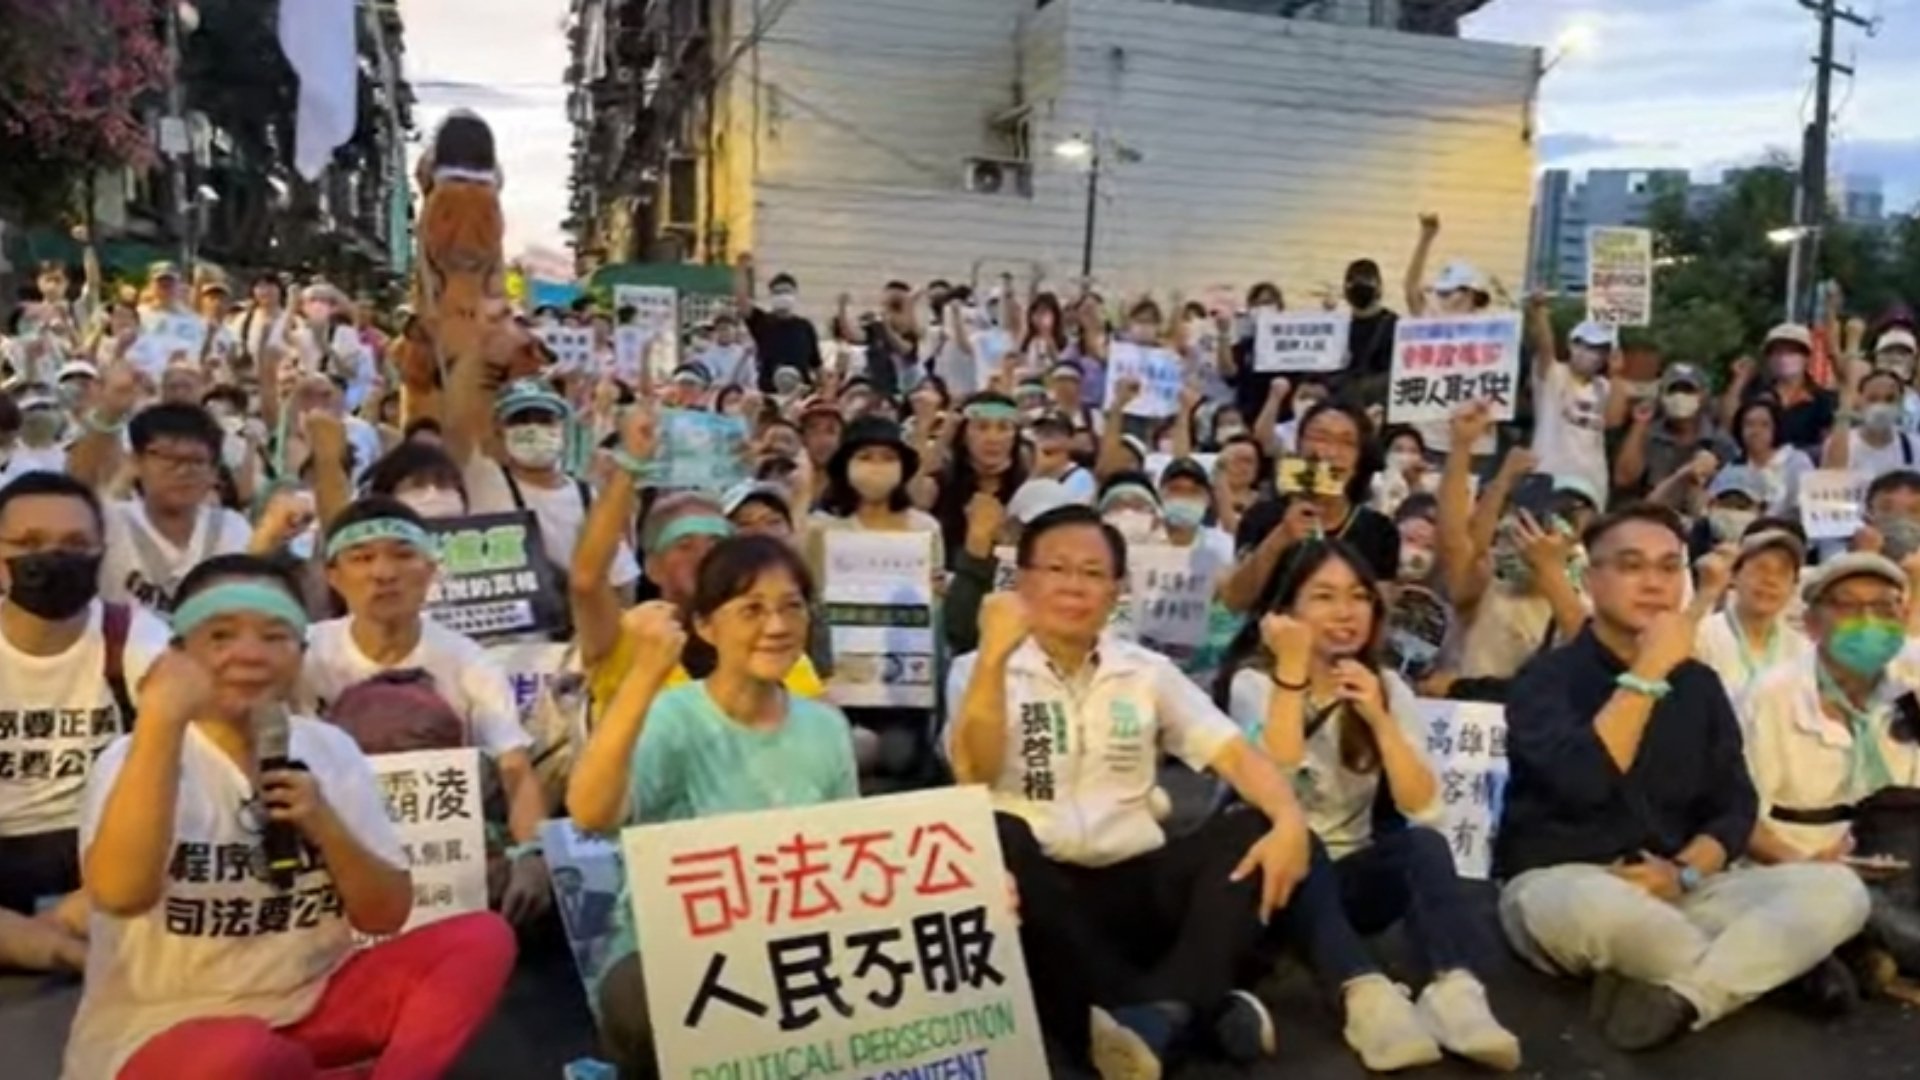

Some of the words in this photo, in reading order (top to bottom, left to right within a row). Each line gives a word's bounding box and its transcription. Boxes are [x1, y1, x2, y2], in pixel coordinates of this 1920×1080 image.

[1394, 373, 1510, 406] 押人取供
[666, 822, 975, 937] 司法不公
[684, 905, 1006, 1032] 人民不服
[849, 1003, 1016, 1068] PERSECUTION
